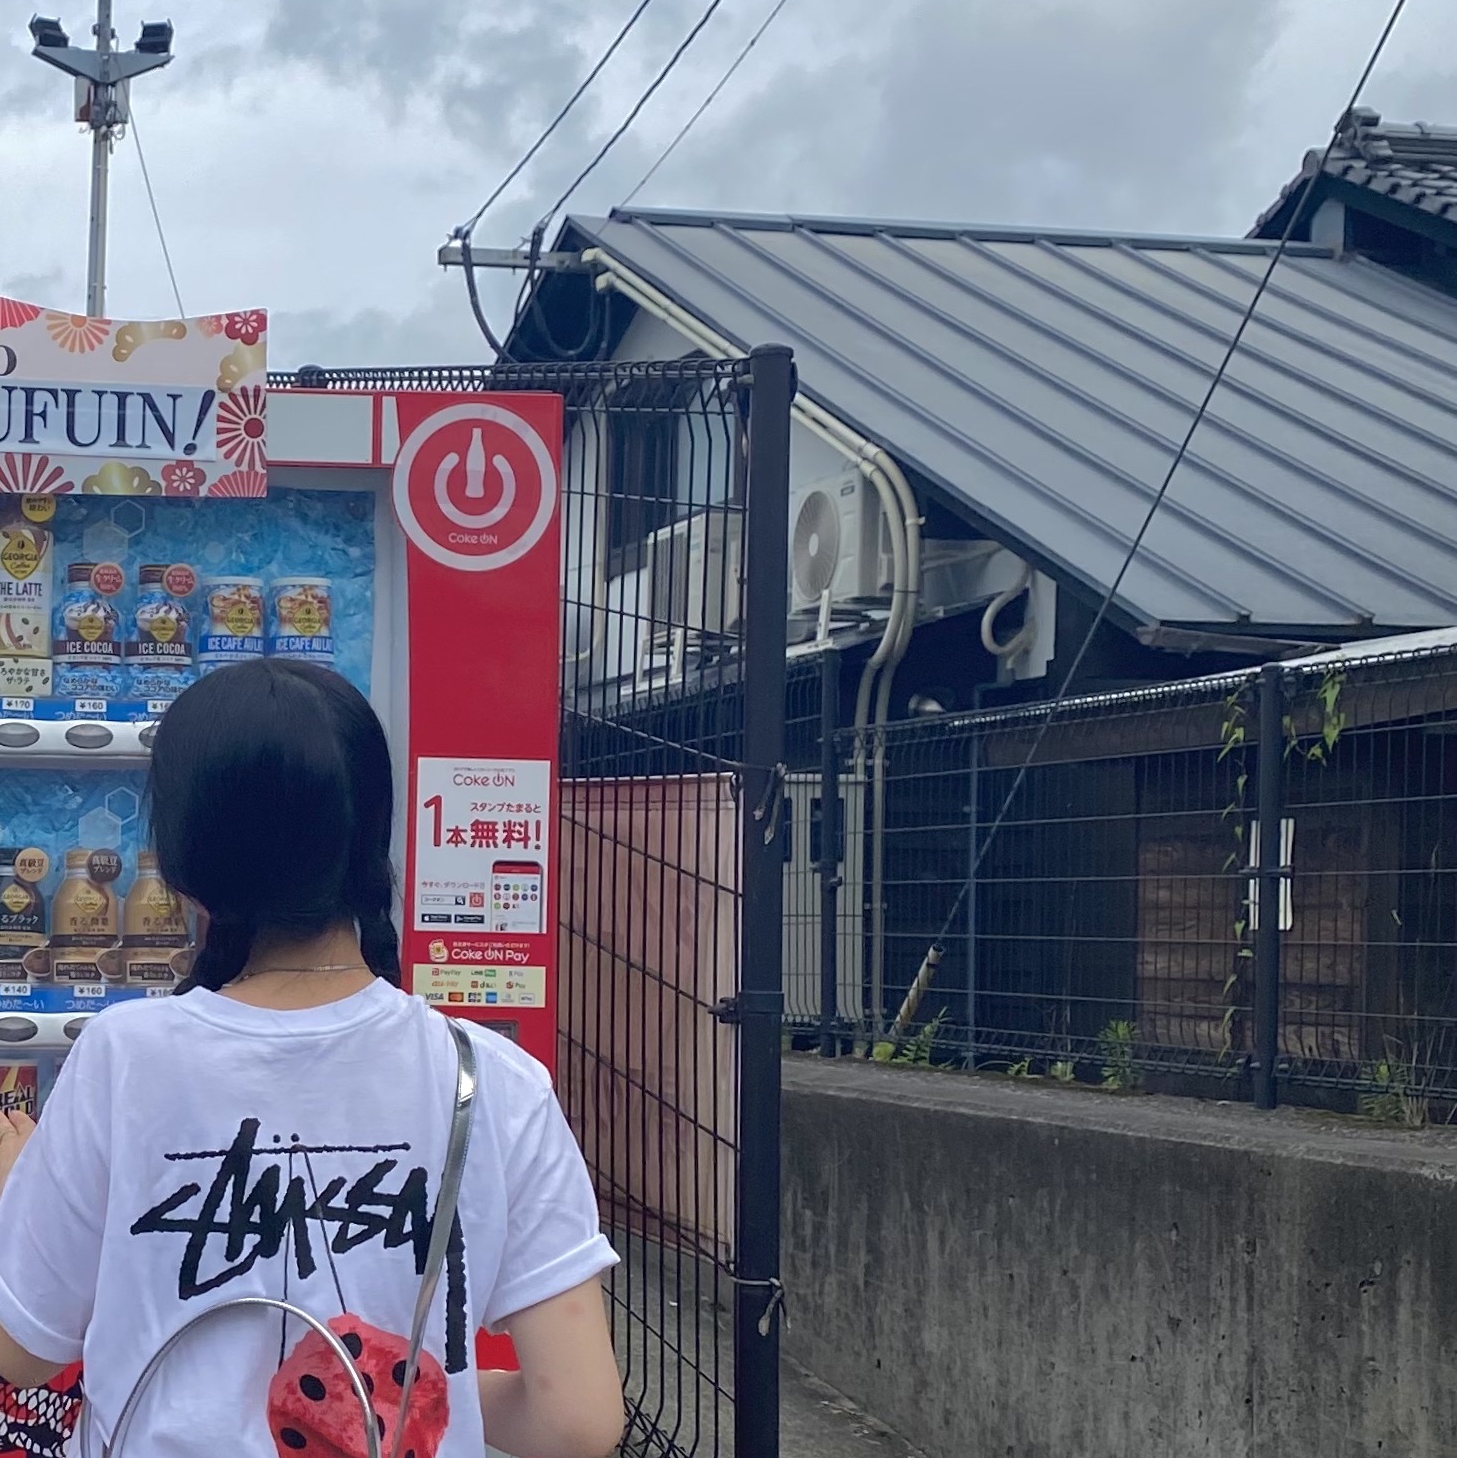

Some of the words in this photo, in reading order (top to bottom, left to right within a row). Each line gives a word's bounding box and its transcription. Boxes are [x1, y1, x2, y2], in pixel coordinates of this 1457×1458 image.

[448, 532, 478, 544] Coke
[15, 581, 43, 597] LATTE
[65, 641, 82, 653] ICE
[83, 641, 114, 653] COCOA
[138, 643, 154, 654] ICE
[155, 643, 186, 655] COCOA
[6, 699, 31, 710] ¥170
[79, 701, 104, 710] ¥160
[452, 773, 490, 787] Coke
[470, 801, 542, 814] スタンプたまると
[451, 947, 483, 960] Coke
[505, 949, 530, 965] Pay
[3, 985, 28, 994] ¥140
[78, 986, 103, 996] ¥160
